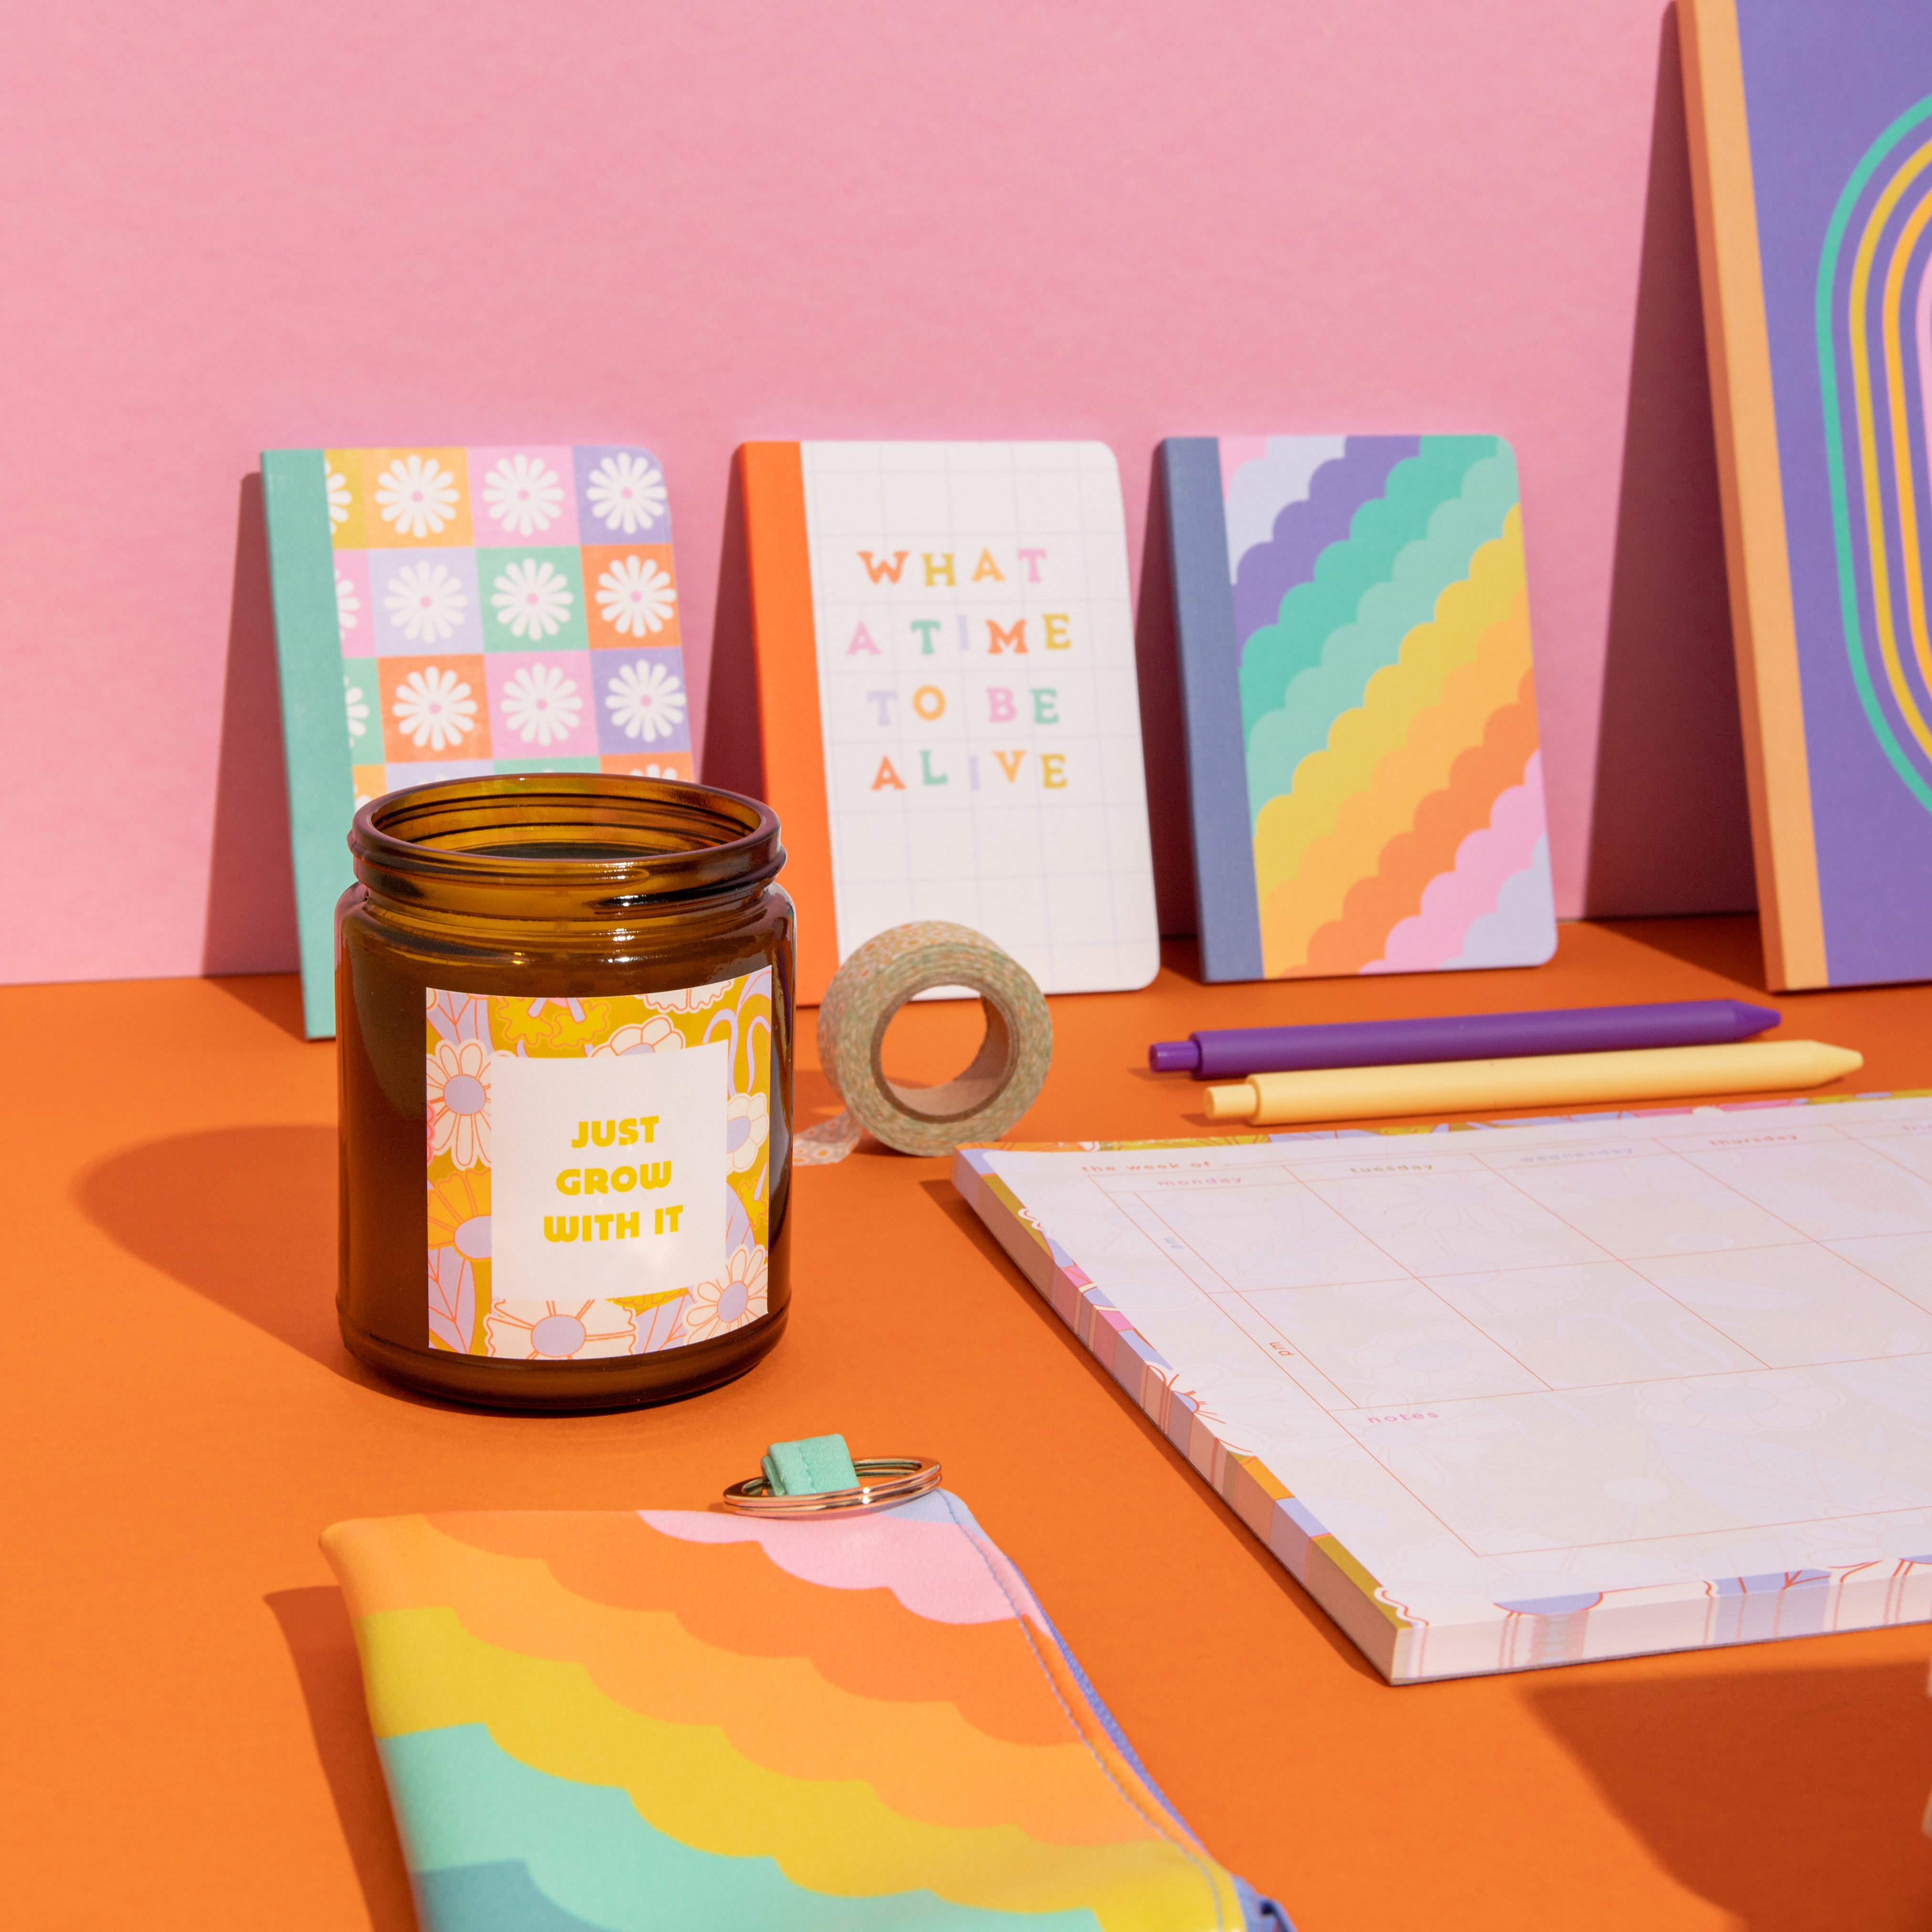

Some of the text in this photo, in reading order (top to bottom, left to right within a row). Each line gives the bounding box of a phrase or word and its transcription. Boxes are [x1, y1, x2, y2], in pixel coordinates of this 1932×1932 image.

[857, 547, 1047, 587] WHAT
[846, 613, 1071, 655] A TIME
[866, 684, 1059, 726] TO BE
[871, 749, 1067, 791] ALIVE
[571, 1115, 659, 1148] JUST
[556, 1160, 672, 1196] GROW
[1157, 1177, 1241, 1186] monday
[1350, 1165, 1433, 1174] tuesday
[1709, 1134, 1797, 1145] thursday
[544, 1205, 683, 1243] WITH IT
[1269, 1342, 1296, 1356] pm
[1367, 1412, 1439, 1424] notes
